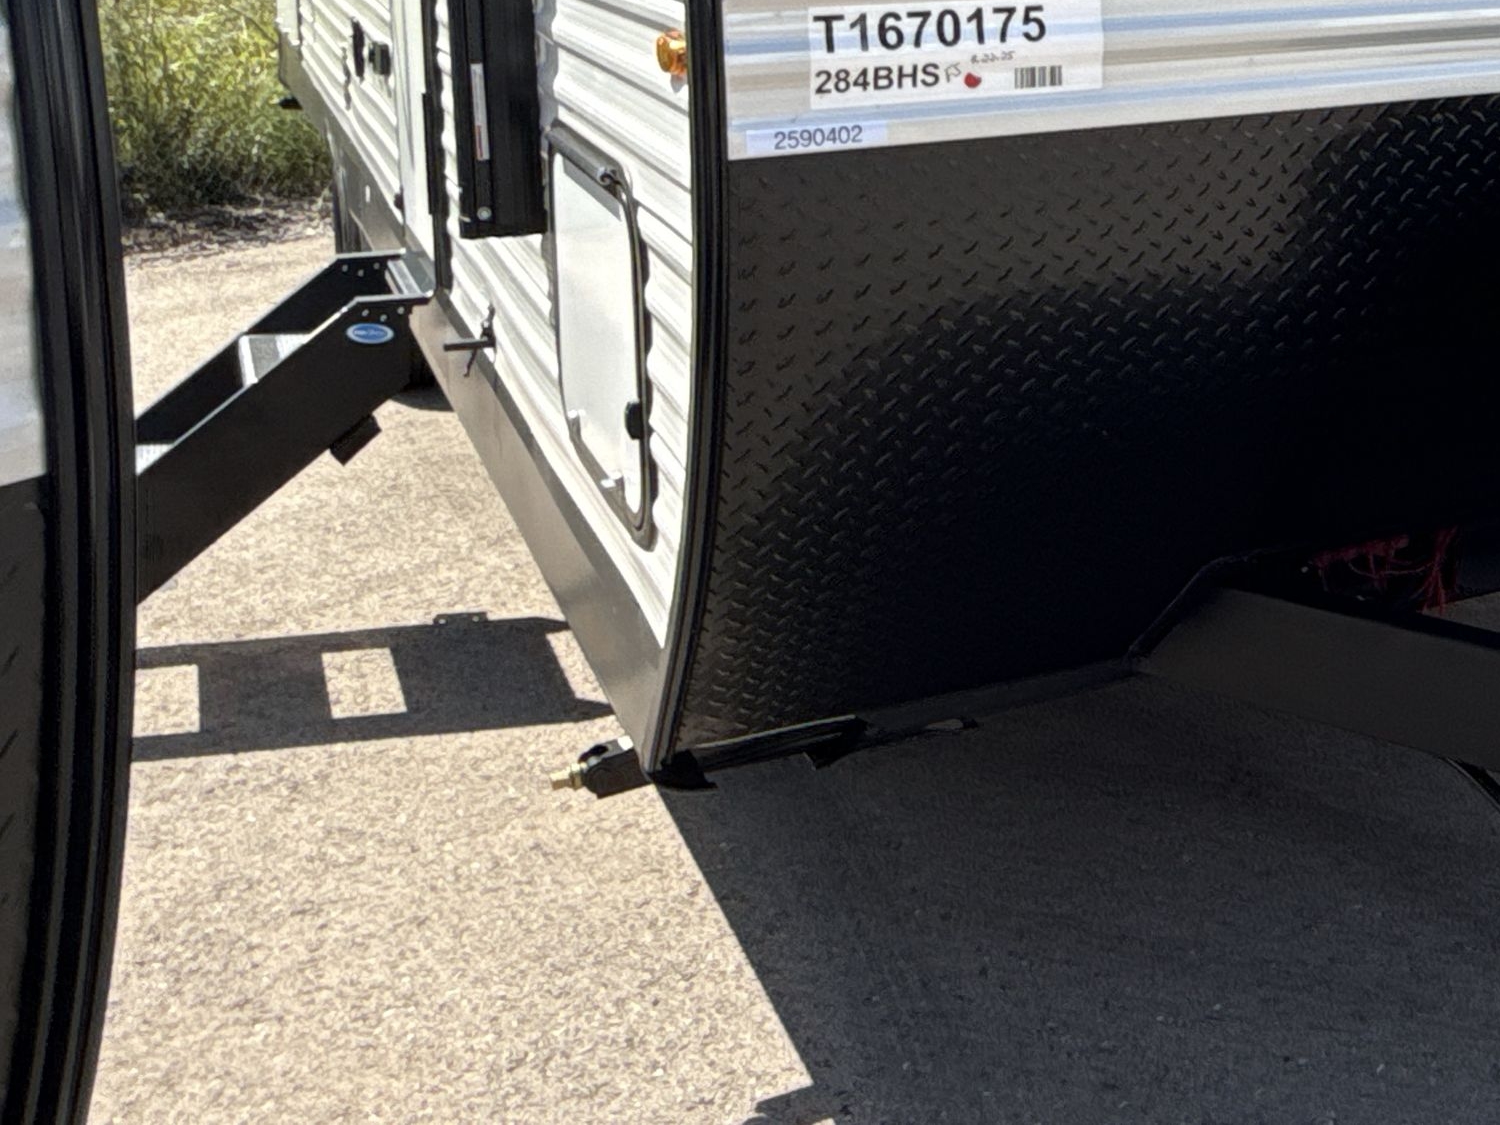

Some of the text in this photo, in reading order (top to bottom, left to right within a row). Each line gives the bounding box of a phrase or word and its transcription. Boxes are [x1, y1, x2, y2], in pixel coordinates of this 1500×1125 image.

[812, 5, 1047, 53] T1670175
[814, 63, 940, 94] 284BHS
[773, 124, 863, 151] 2590402
